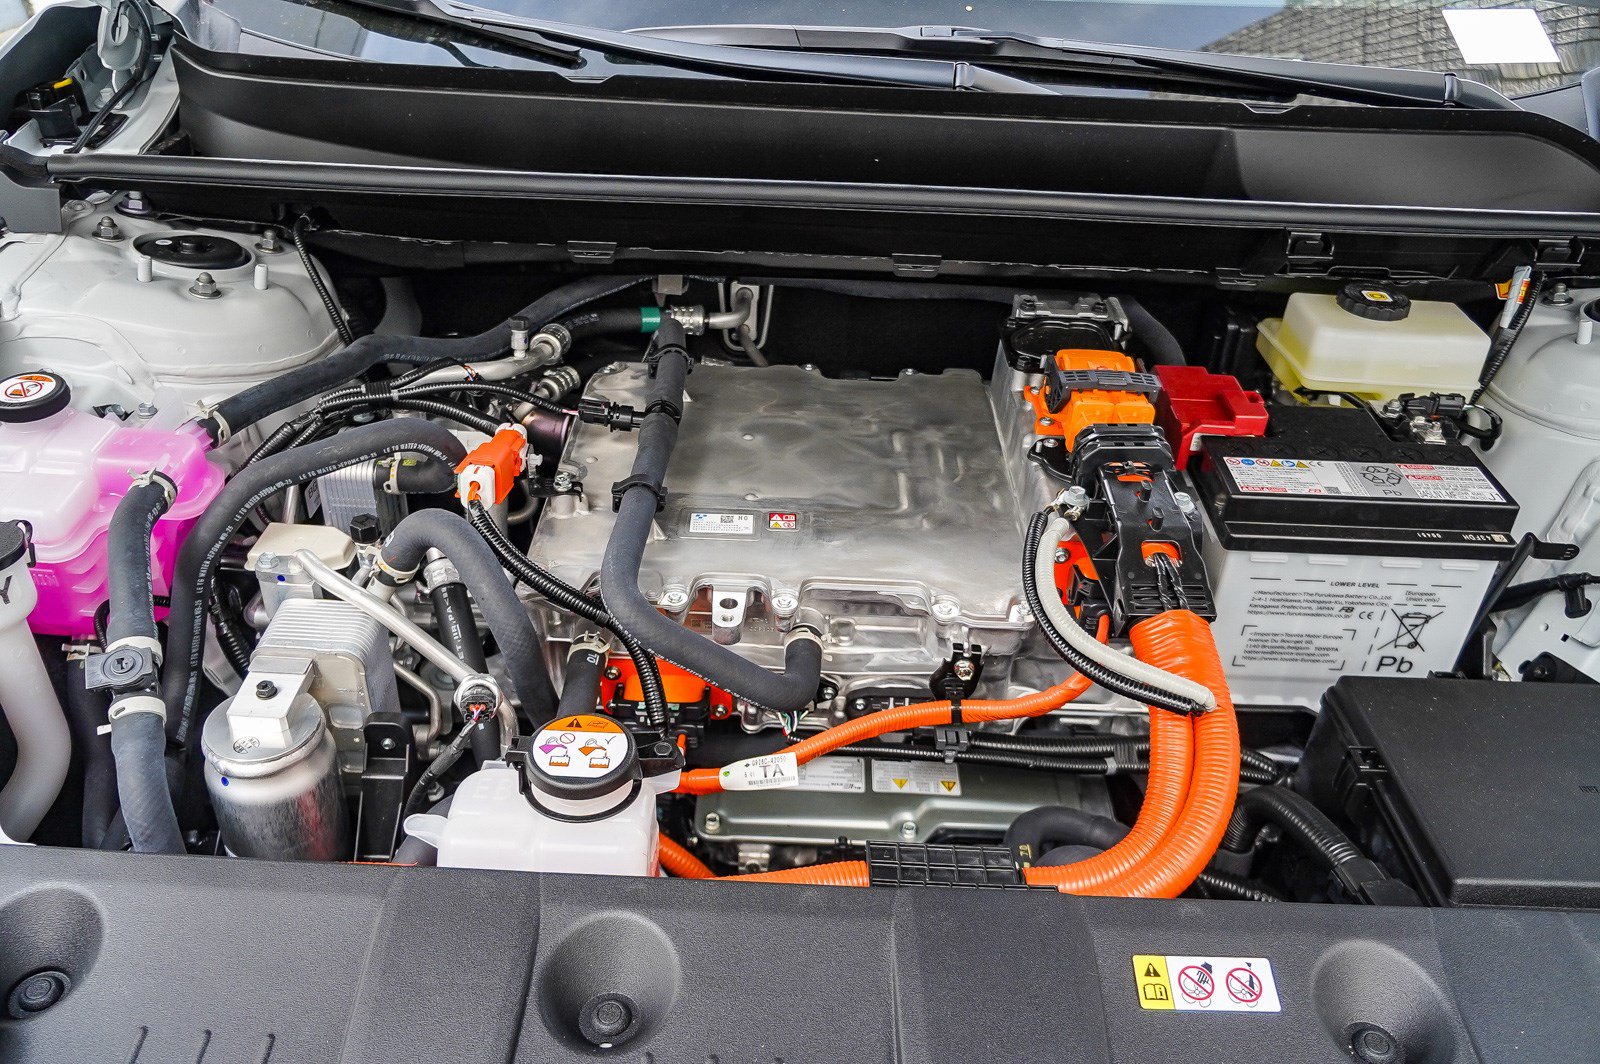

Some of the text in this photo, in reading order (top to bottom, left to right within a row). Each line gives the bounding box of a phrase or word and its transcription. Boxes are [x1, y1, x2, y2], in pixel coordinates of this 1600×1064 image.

[317, 464, 337, 474] WATER
[244, 495, 260, 509] WATER
[1376, 656, 1413, 673] Pb
[759, 764, 784, 778] TA
